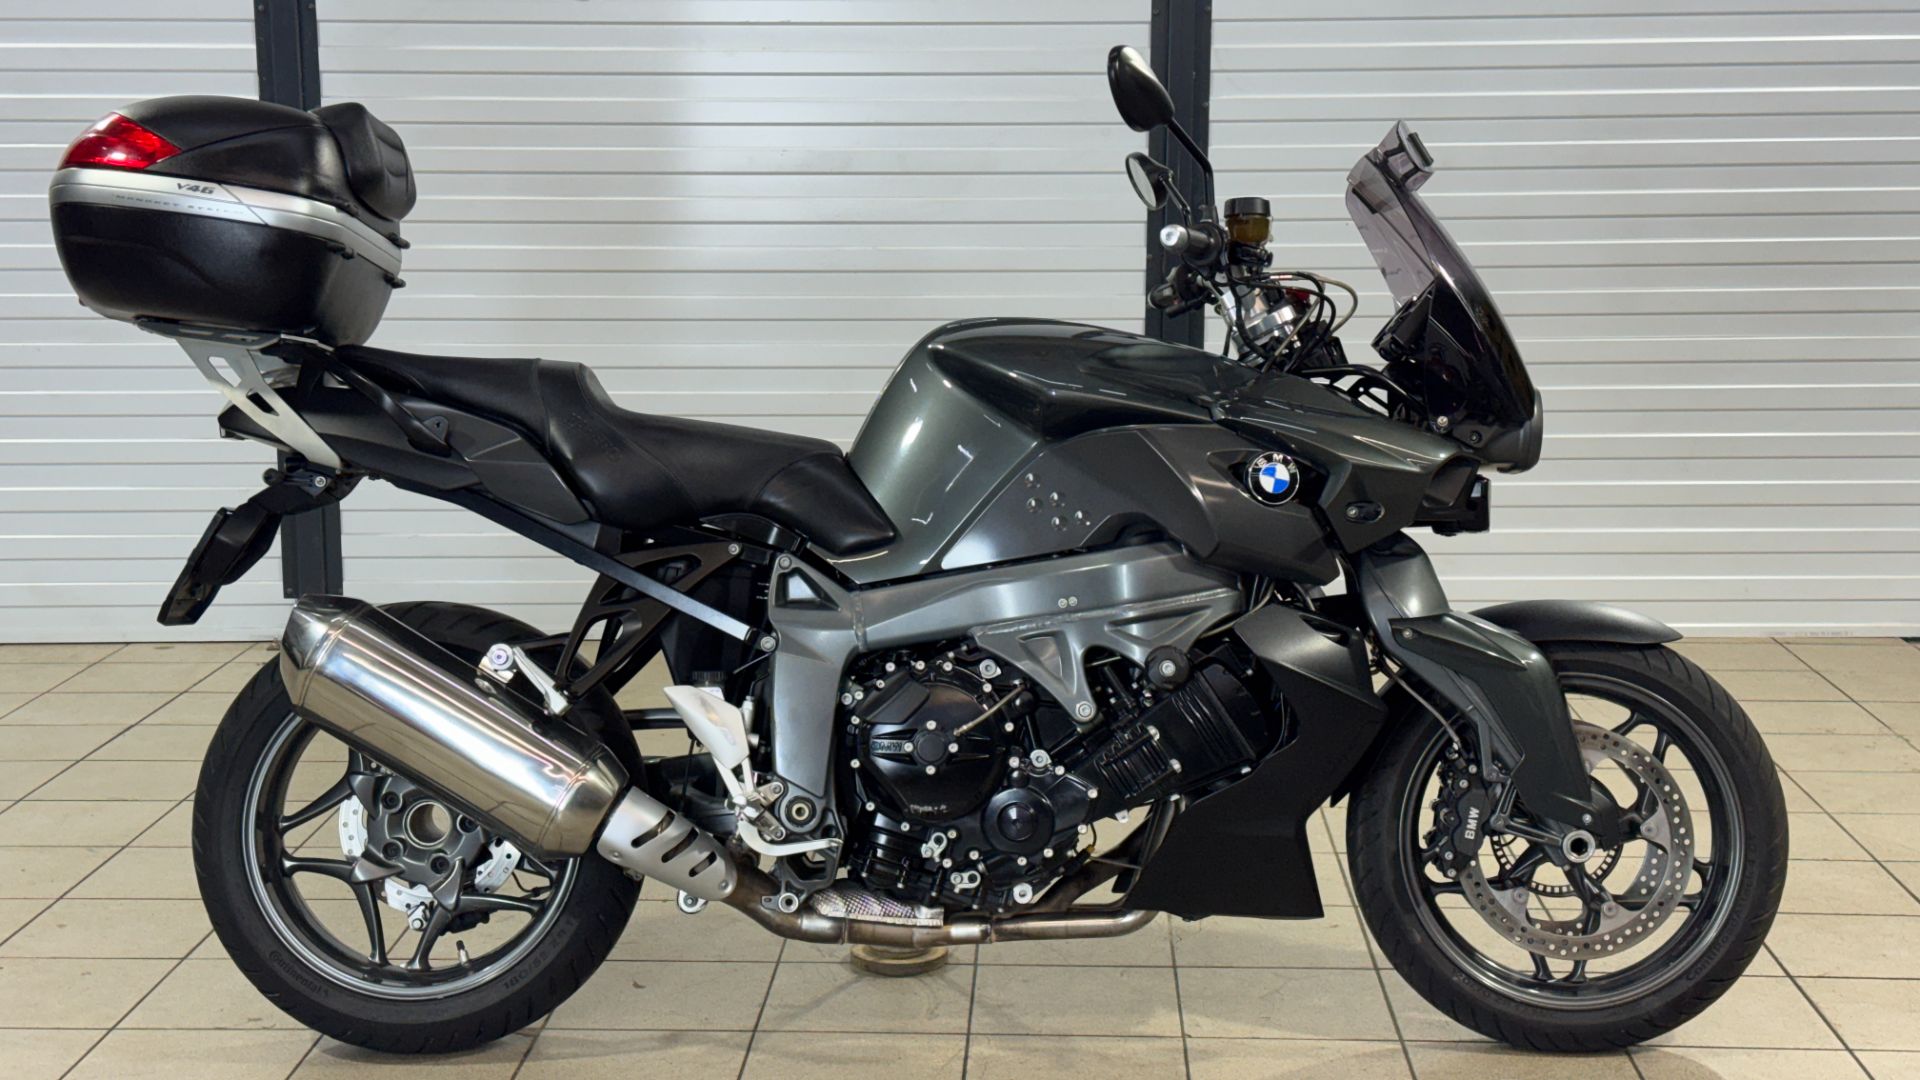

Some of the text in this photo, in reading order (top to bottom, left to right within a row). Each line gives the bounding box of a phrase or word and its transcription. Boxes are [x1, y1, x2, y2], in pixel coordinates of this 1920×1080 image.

[177, 183, 215, 194] V46
[1255, 453, 1297, 474] BMW
[1464, 806, 1480, 840] BMW
